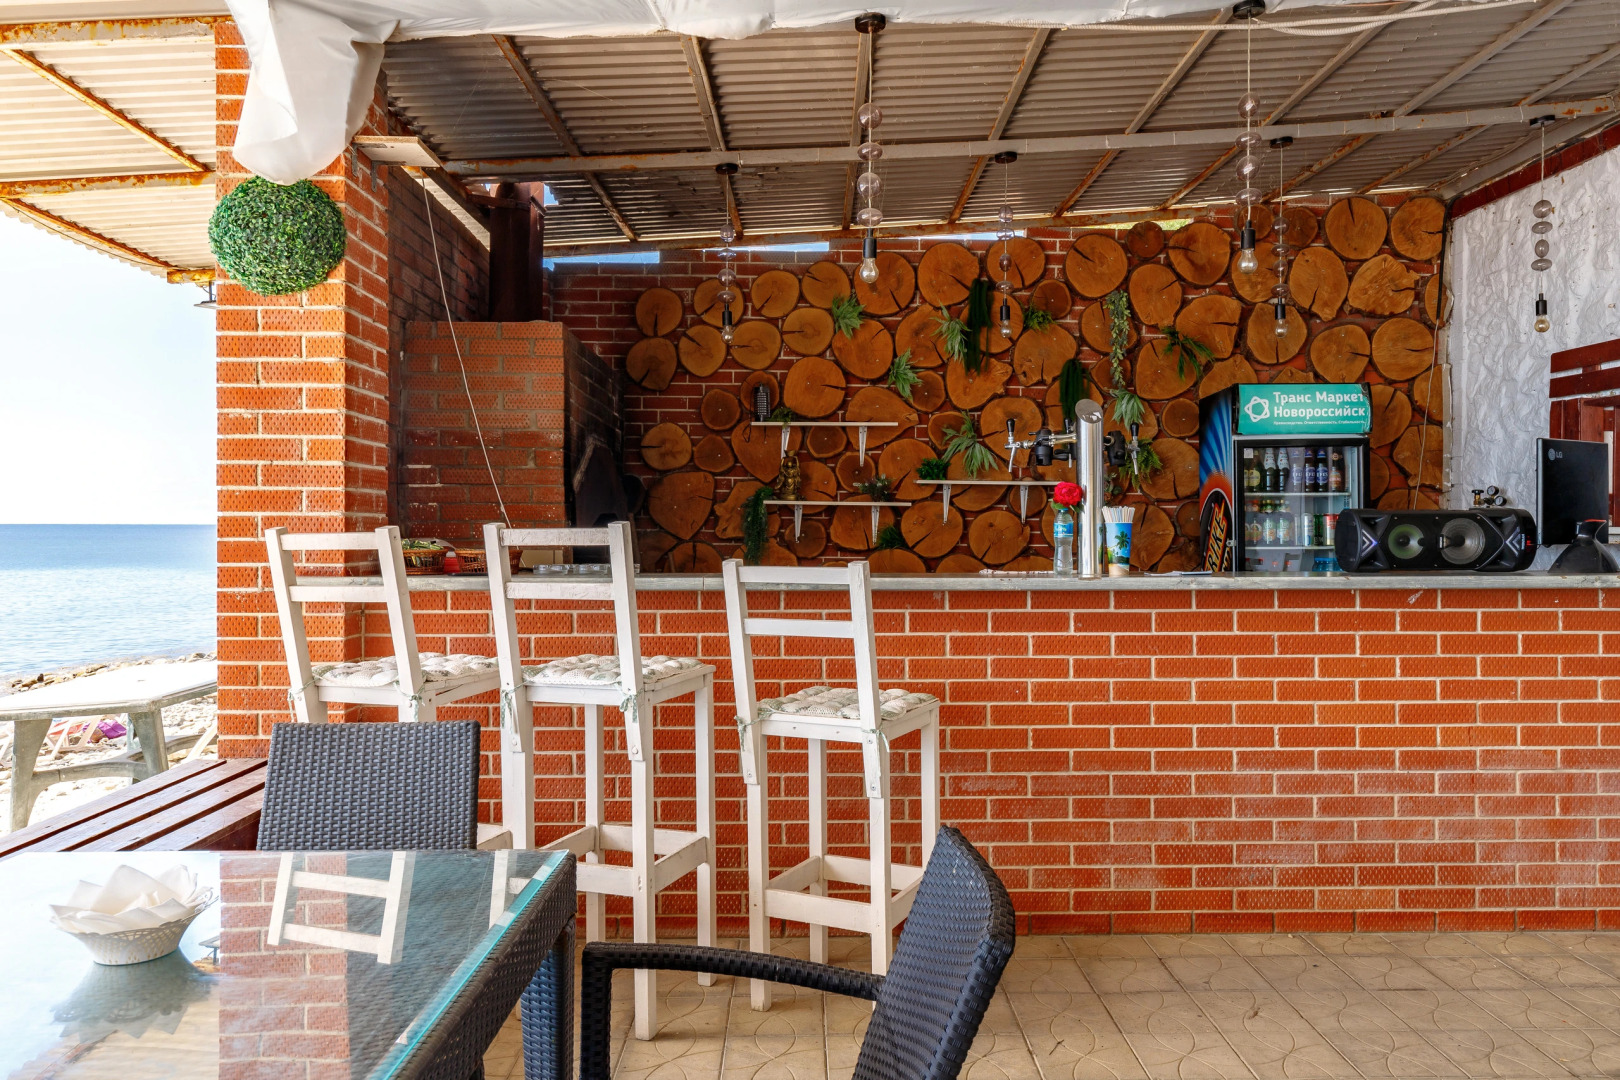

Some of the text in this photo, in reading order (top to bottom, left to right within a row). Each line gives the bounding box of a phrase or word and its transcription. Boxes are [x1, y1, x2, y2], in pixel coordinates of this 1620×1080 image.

[1273, 391, 1364, 406] Транс Маркет
[1273, 405, 1365, 419] Новороссийск
[1555, 451, 1563, 459] LG
